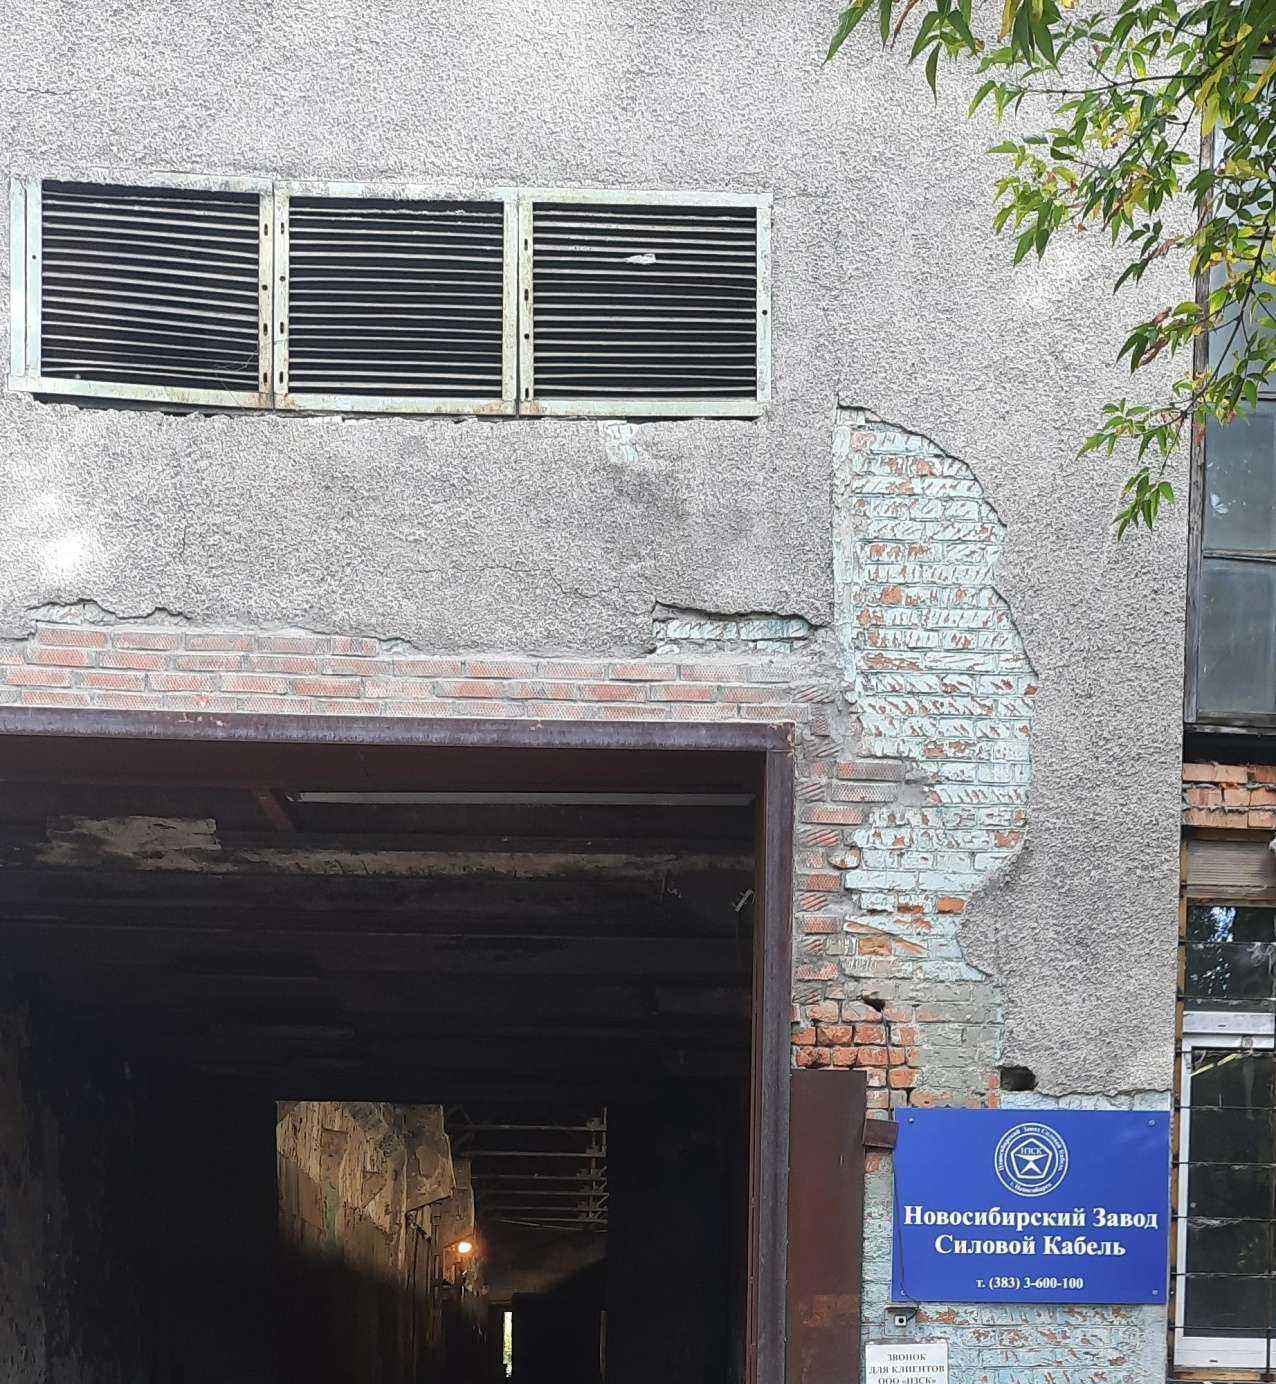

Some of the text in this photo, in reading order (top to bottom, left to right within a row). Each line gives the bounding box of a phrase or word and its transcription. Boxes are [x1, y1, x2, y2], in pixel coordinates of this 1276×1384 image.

[903, 1205, 1158, 1232] Новосибирский Завод
[934, 1234, 1126, 1256] Силовой Кабель
[989, 1276, 1021, 1290] (383)
[1023, 1277, 1084, 1290] 3-600-100
[888, 1353, 927, 1361] ЗВОНОК
[869, 1365, 945, 1374] ДЛЯ КЛИЕНТОВ
[878, 1377, 900, 1384] ООО
